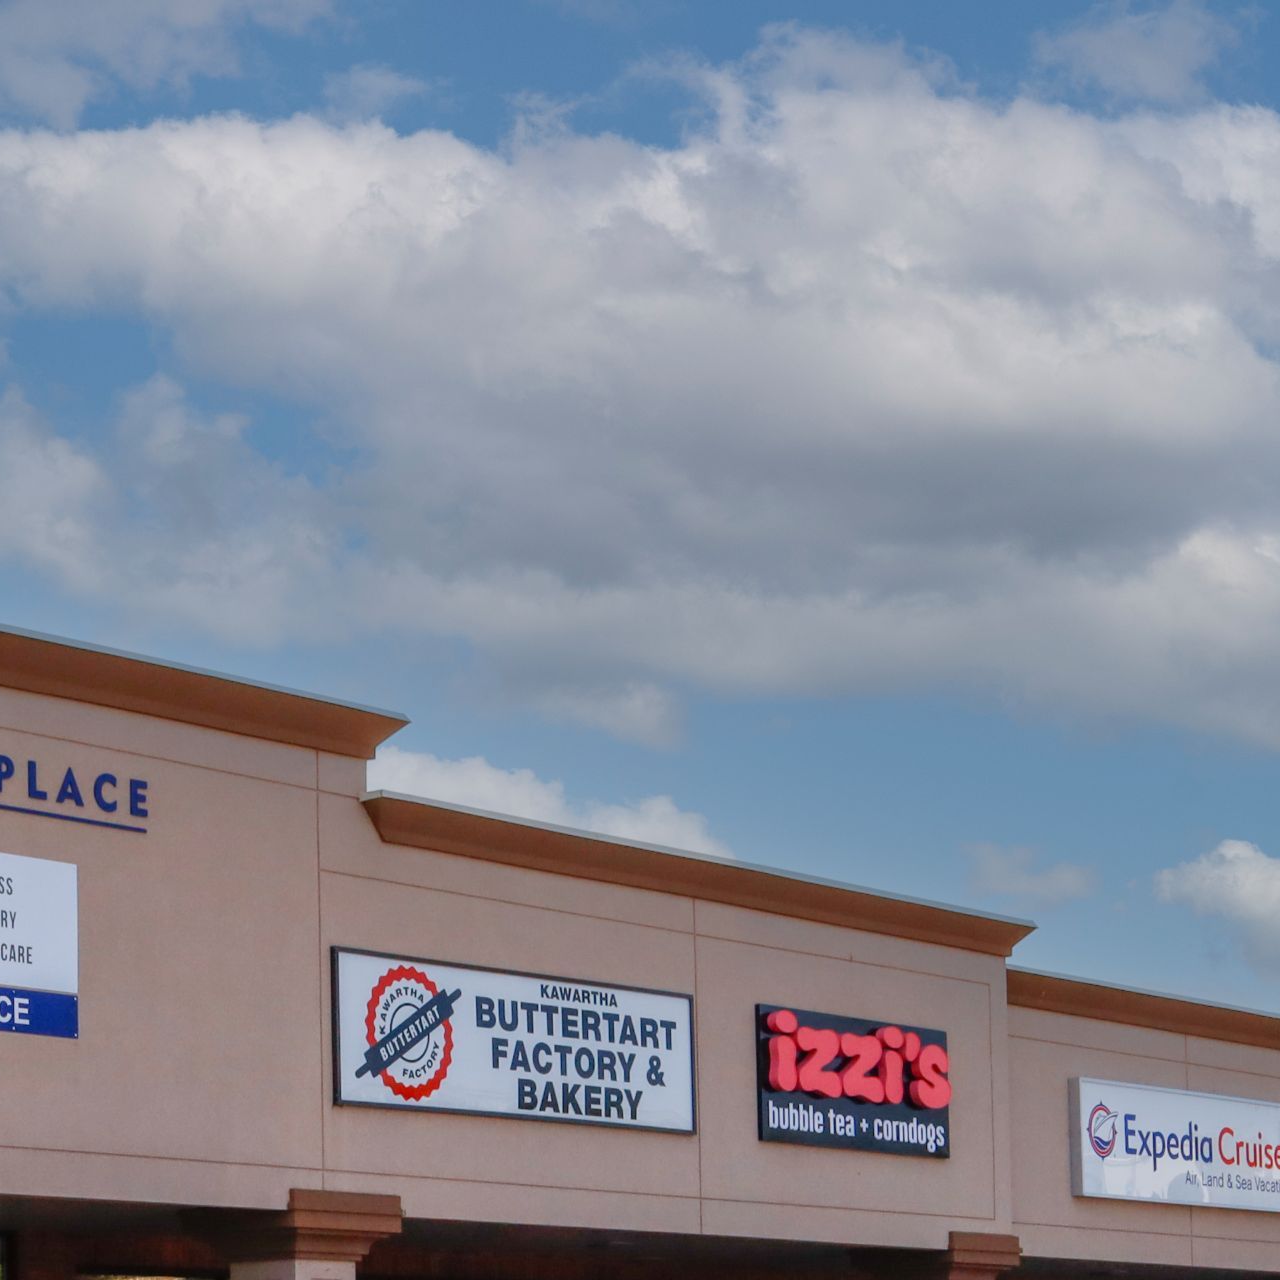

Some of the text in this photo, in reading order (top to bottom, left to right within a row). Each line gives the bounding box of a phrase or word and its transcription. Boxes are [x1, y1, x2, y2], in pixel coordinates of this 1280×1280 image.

[379, 986, 425, 1035] KAWARTHA
[540, 983, 618, 1008] KAWARTHA
[379, 1004, 441, 1063] BUTTERTART
[475, 995, 677, 1051] BUTTERTART
[402, 1041, 440, 1080] FACTORY
[491, 1037, 666, 1088] FACTORY &
[767, 1009, 952, 1110] izzi's
[517, 1078, 643, 1121] BAKERY
[768, 1099, 945, 1153] bubble tea + corndogs
[1123, 1113, 1213, 1172] Expedia
[1185, 1171, 1200, 1188] Air,
[1202, 1172, 1224, 1188] Land
[1227, 1174, 1233, 1189] &
[1235, 1174, 1252, 1191] Sea
